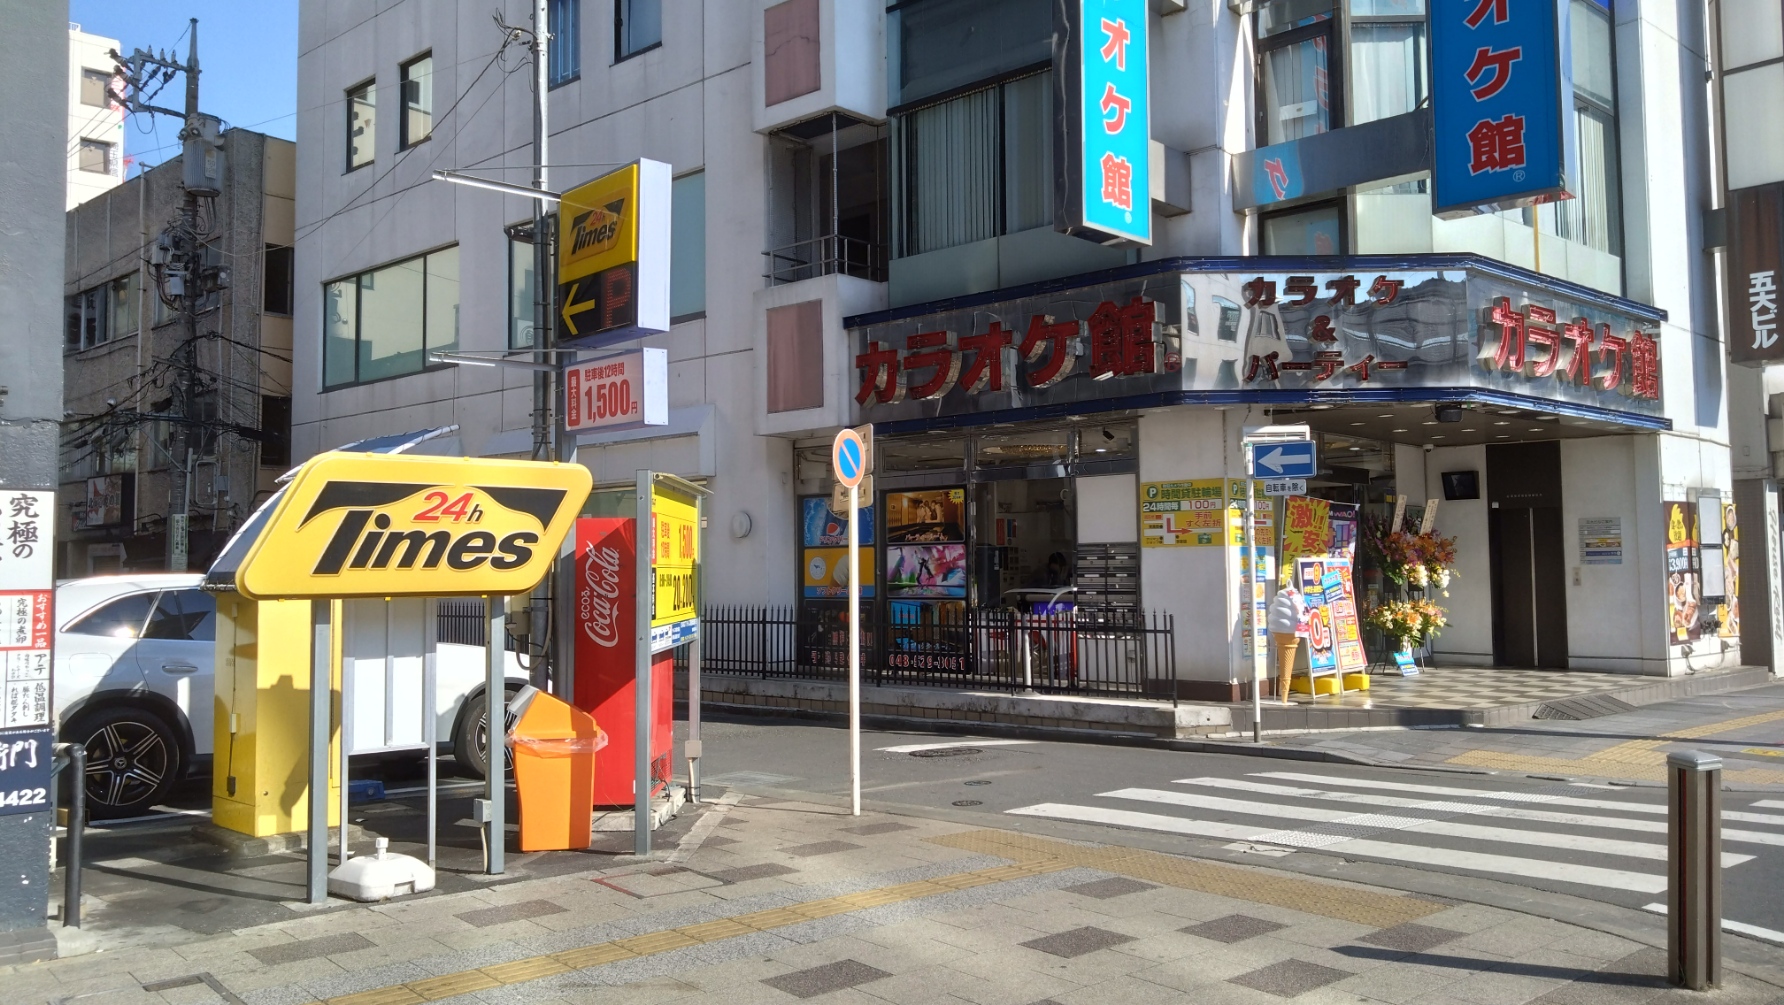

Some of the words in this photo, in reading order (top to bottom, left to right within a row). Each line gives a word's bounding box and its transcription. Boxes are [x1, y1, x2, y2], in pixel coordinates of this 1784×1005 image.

[570, 215, 618, 255] Times
[603, 268, 631, 328] P
[1242, 275, 1405, 308] カラオケ
[1749, 270, 1779, 349] 五大ビル
[855, 296, 1162, 405] カラオケ館
[1308, 315, 1339, 343] &
[1486, 296, 1660, 400] カラオケ館
[584, 362, 625, 382] 駐車後12時間
[584, 379, 638, 423] 1,500円
[411, 491, 484, 523] 24h
[1161, 487, 1222, 499] 時間貸駐輪場
[1265, 482, 1304, 493] 自転車を除く
[7, 493, 40, 559] 究極の
[305, 500, 544, 576] Times
[584, 540, 620, 648] Coca-Cola
[16, 597, 28, 644] 究極の煮卵
[34, 593, 48, 648] おすすめ一品
[33, 653, 47, 675] アテ
[33, 682, 46, 722] 低温調理
